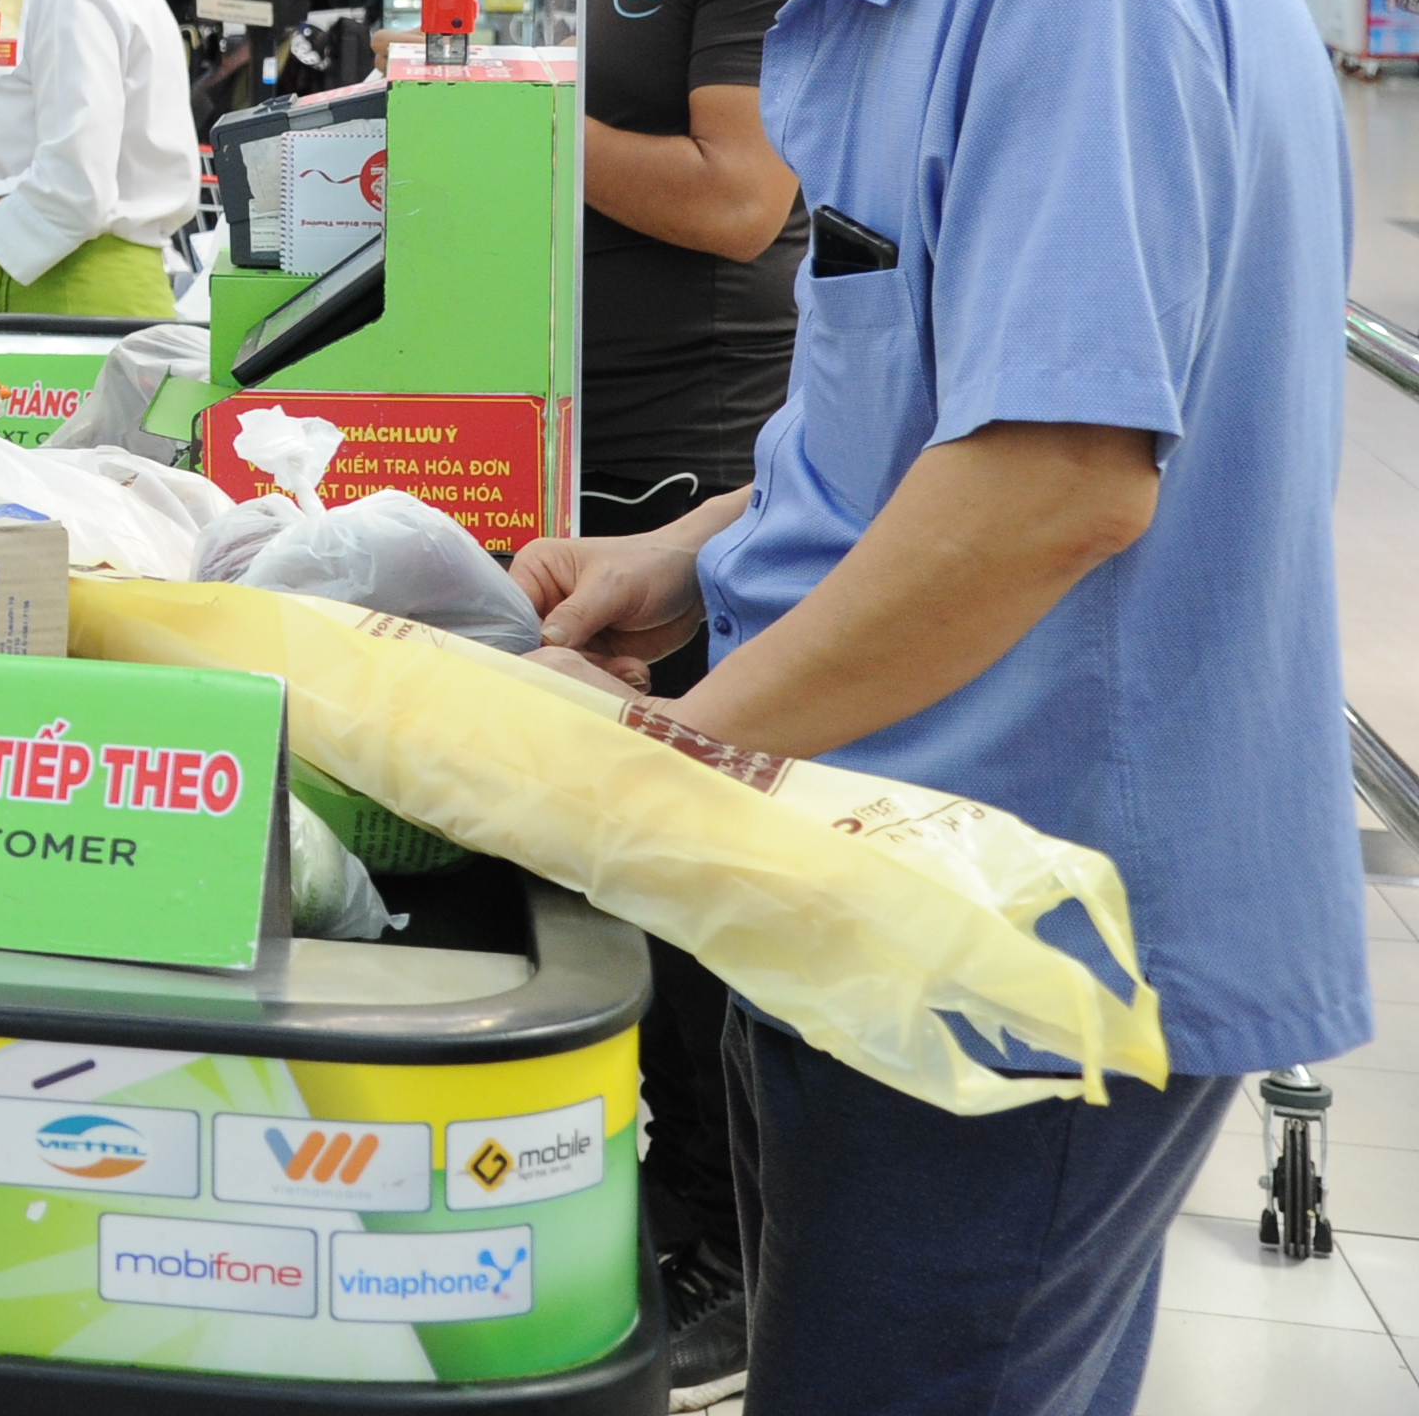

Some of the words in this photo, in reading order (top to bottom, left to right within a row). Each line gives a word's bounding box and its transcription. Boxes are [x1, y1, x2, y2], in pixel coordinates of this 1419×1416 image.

[7, 381, 81, 420] HÀNG
[405, 425, 442, 444] LƯU
[444, 424, 458, 444] Ý
[336, 451, 378, 475] KIỂM
[384, 459, 420, 476] TRA
[425, 456, 464, 476] HÓA
[469, 457, 511, 477] ĐƠN
[406, 480, 458, 502] HÀNG
[463, 481, 503, 502] HÓA
[484, 507, 535, 528] TOÁN
[484, 537, 512, 552] ơn!
[102, 744, 243, 816] THEO
[519, 1129, 591, 1168] mobile
[115, 1245, 303, 1288] mobifone
[338, 1270, 489, 1301] vinaphone
